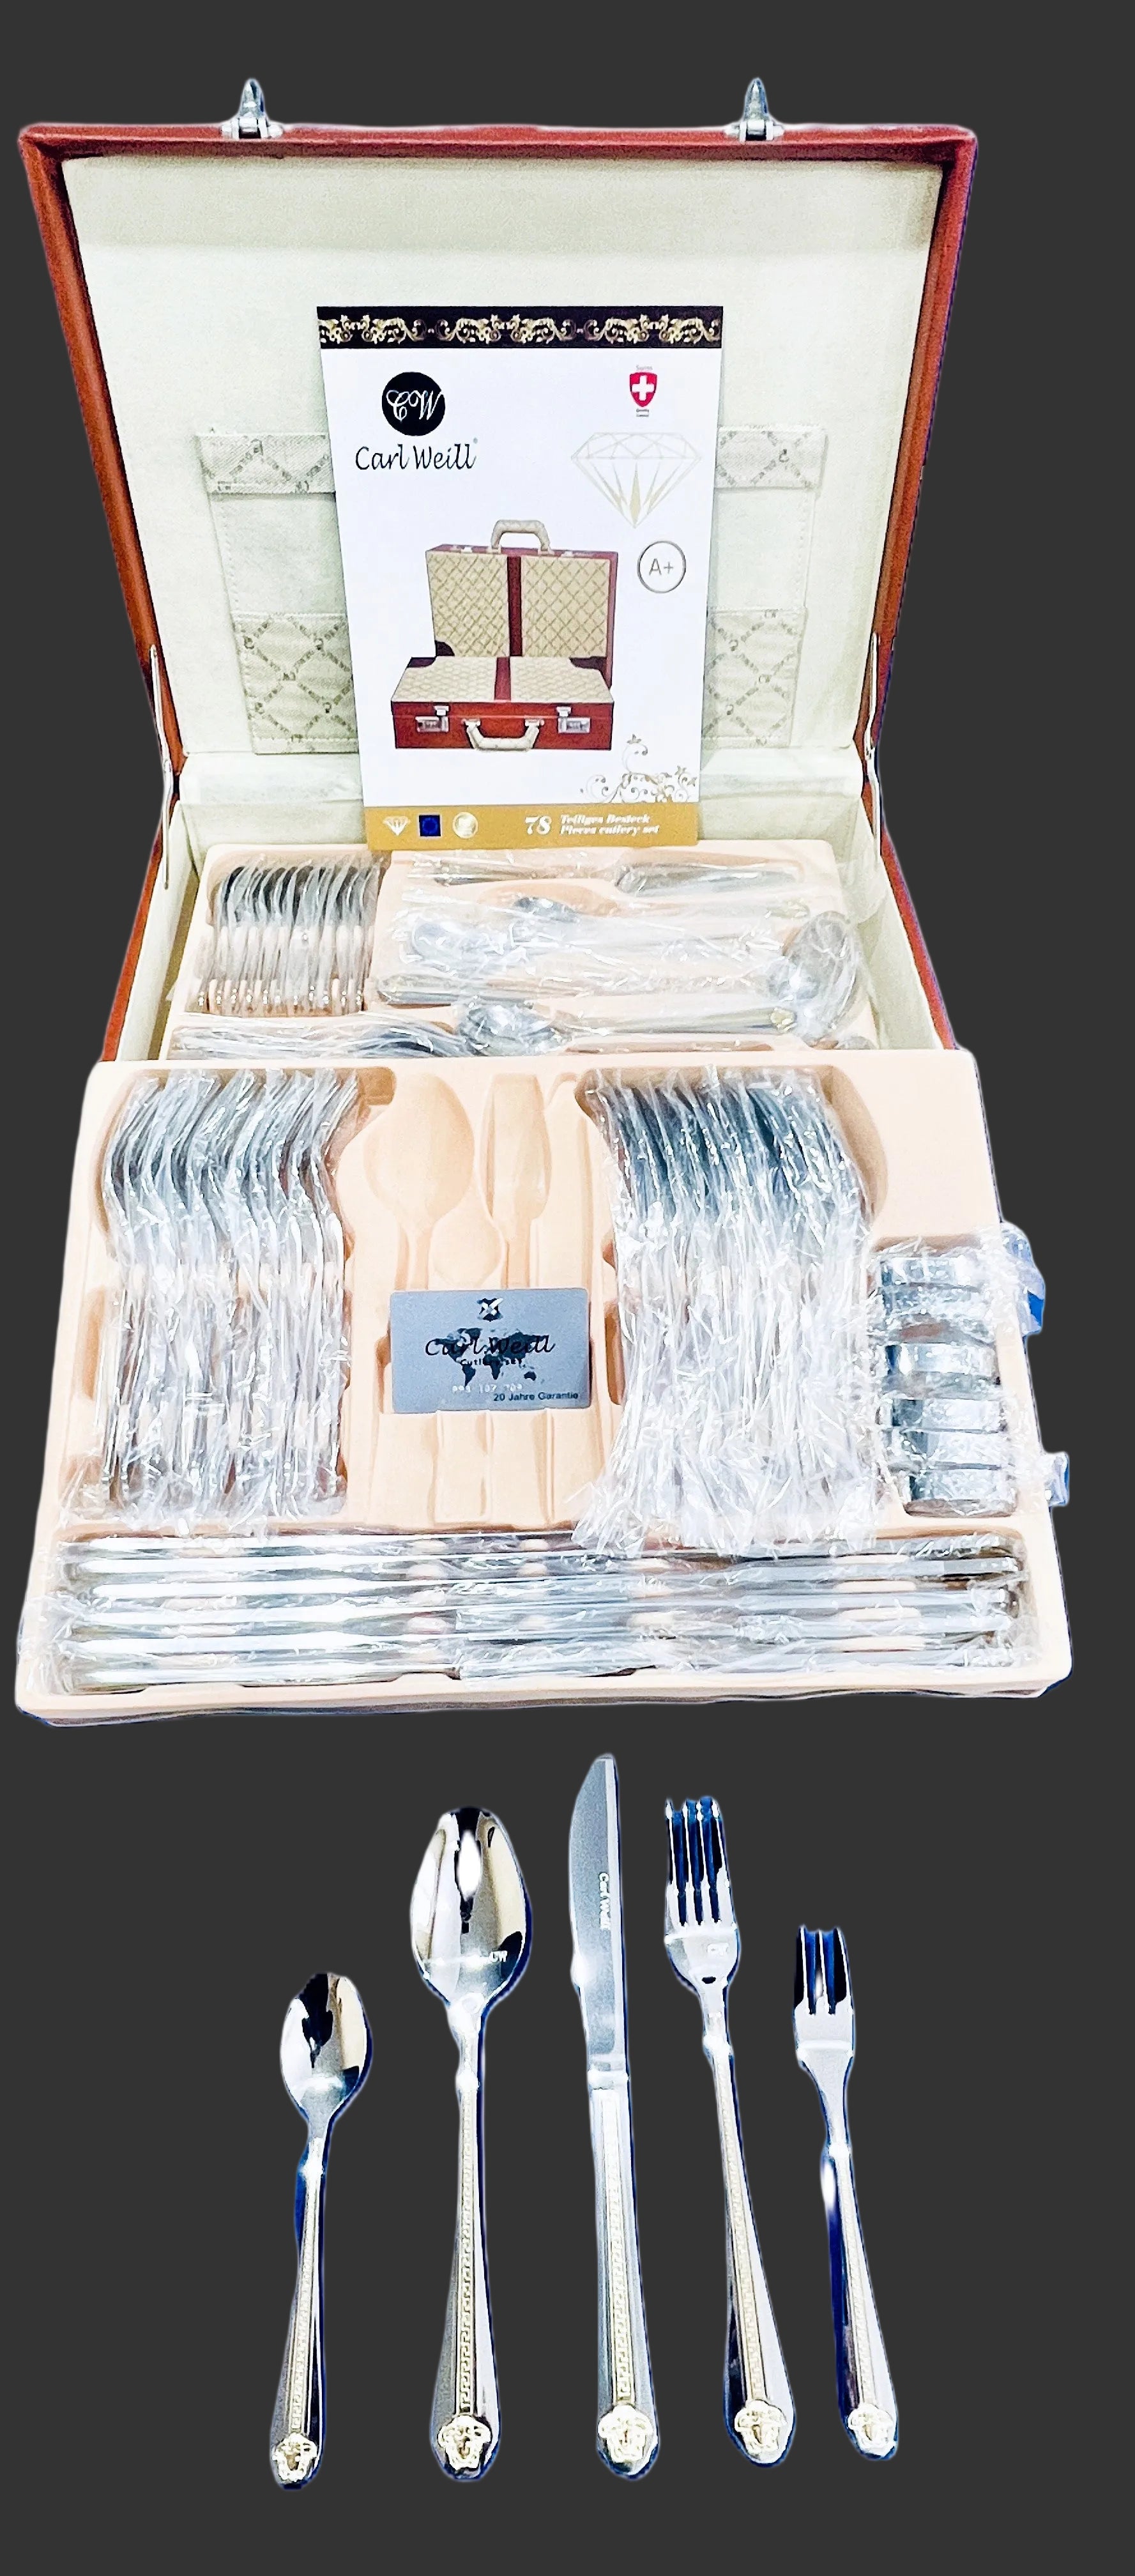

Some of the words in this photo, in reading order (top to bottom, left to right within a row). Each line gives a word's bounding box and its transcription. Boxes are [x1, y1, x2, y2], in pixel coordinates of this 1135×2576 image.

[356, 443, 410, 470] Carl
[413, 443, 476, 470] Weill
[648, 558, 674, 576] A+
[524, 815, 552, 835] 78
[494, 1393, 505, 1401] 20
[508, 1392, 535, 1401] Jahre
[538, 1391, 579, 1400] Garantie
